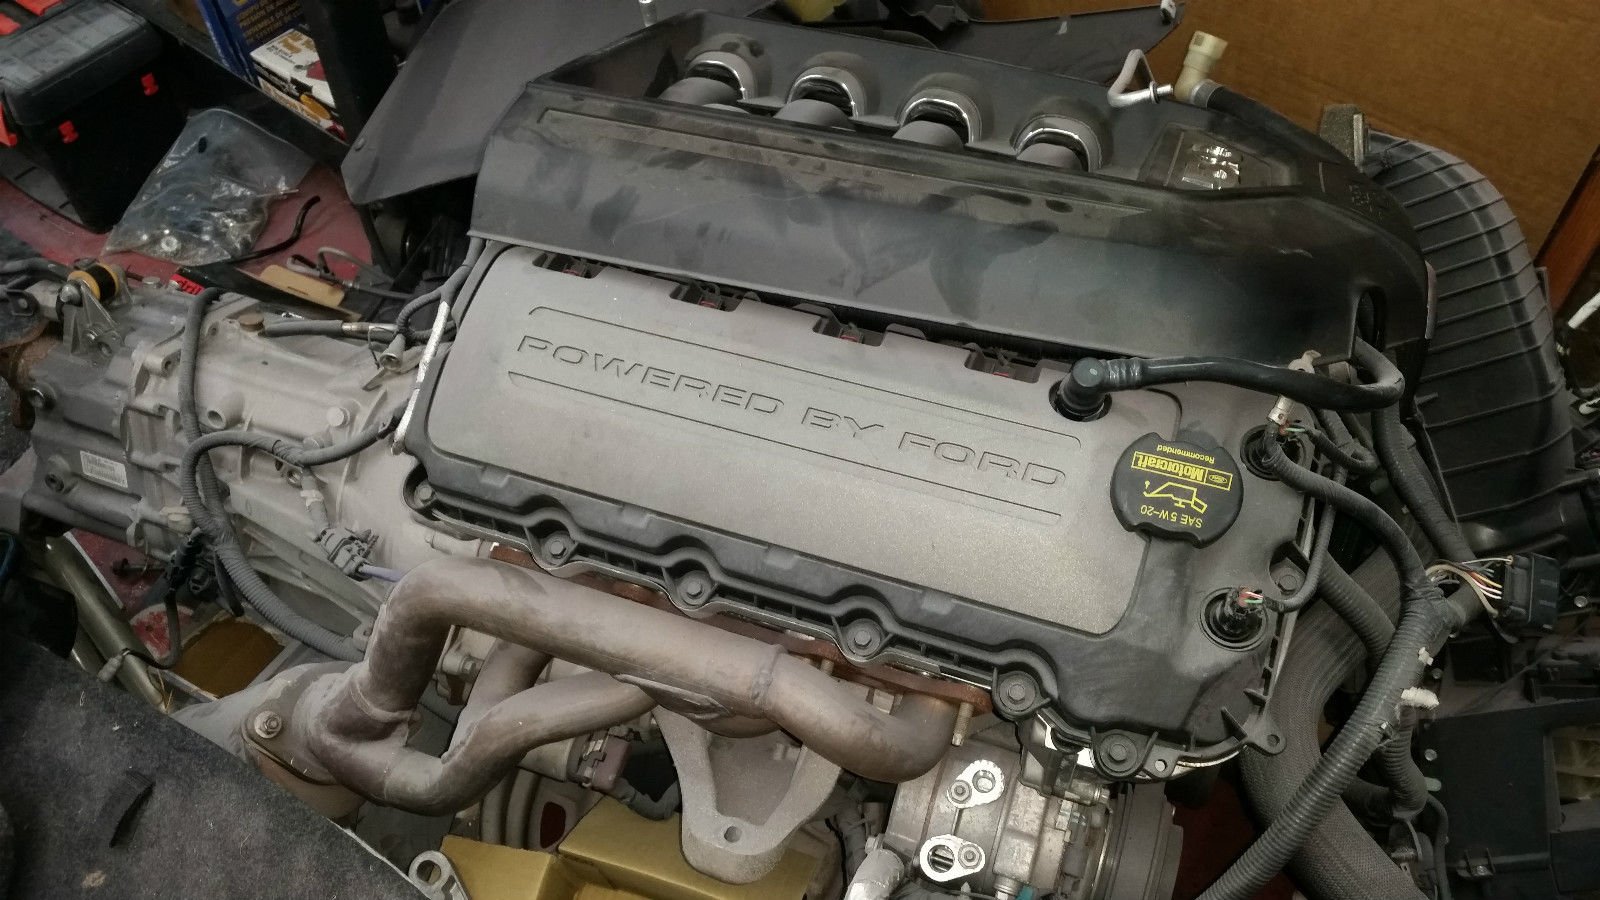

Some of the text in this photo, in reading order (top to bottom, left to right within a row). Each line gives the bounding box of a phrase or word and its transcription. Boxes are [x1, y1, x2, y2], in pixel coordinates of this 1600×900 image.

[517, 335, 1067, 486] POWERED BY FORD
[1156, 444, 1215, 465] Recommended
[1137, 455, 1205, 482] Motorcraft
[1180, 514, 1204, 529] SAE
